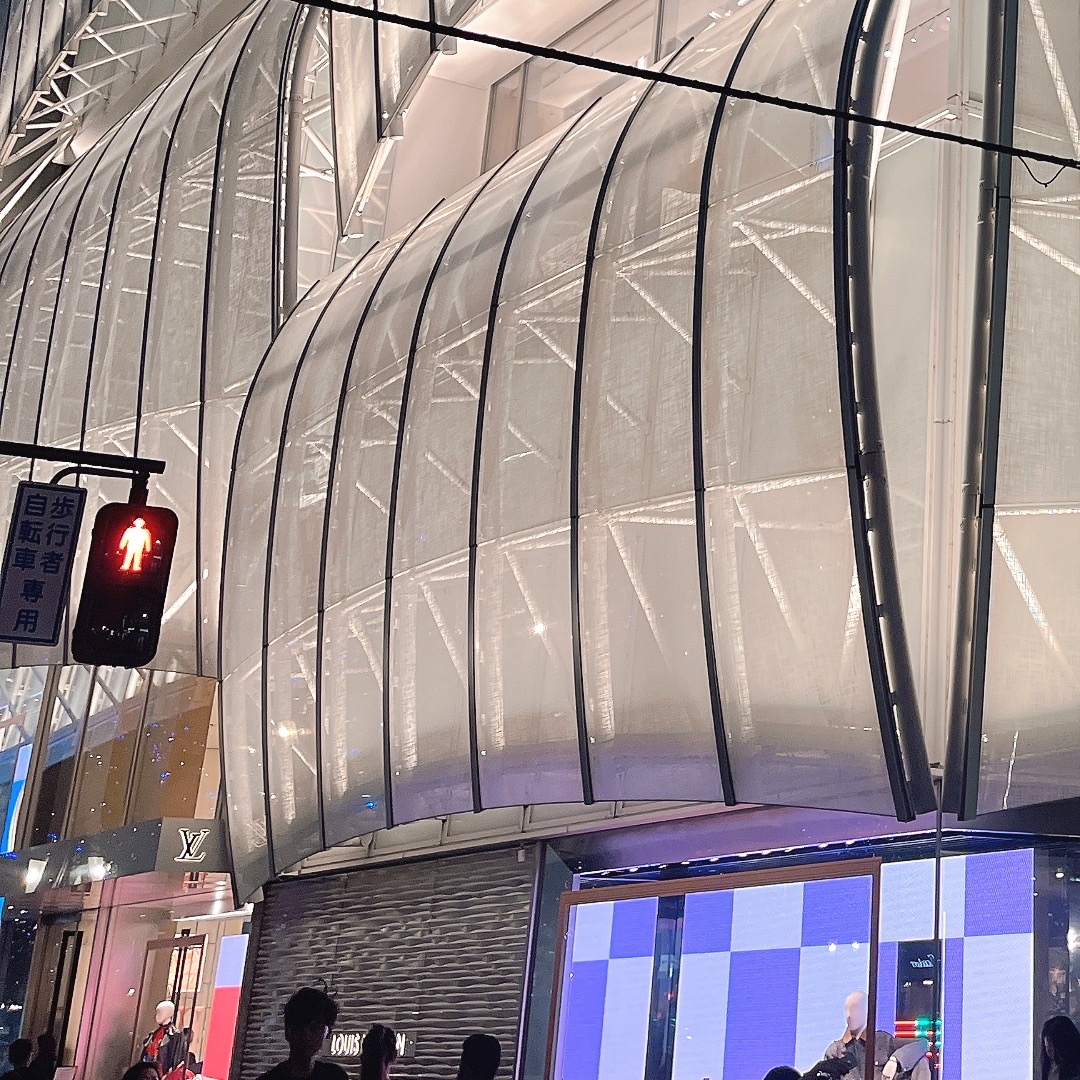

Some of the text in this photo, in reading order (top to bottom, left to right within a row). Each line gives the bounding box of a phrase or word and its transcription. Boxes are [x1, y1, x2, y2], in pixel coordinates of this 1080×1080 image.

[12, 493, 48, 571] 自転車
[40, 496, 76, 575] 歩行者
[12, 578, 46, 633] 専用
[331, 1033, 360, 1056] LOUIS
